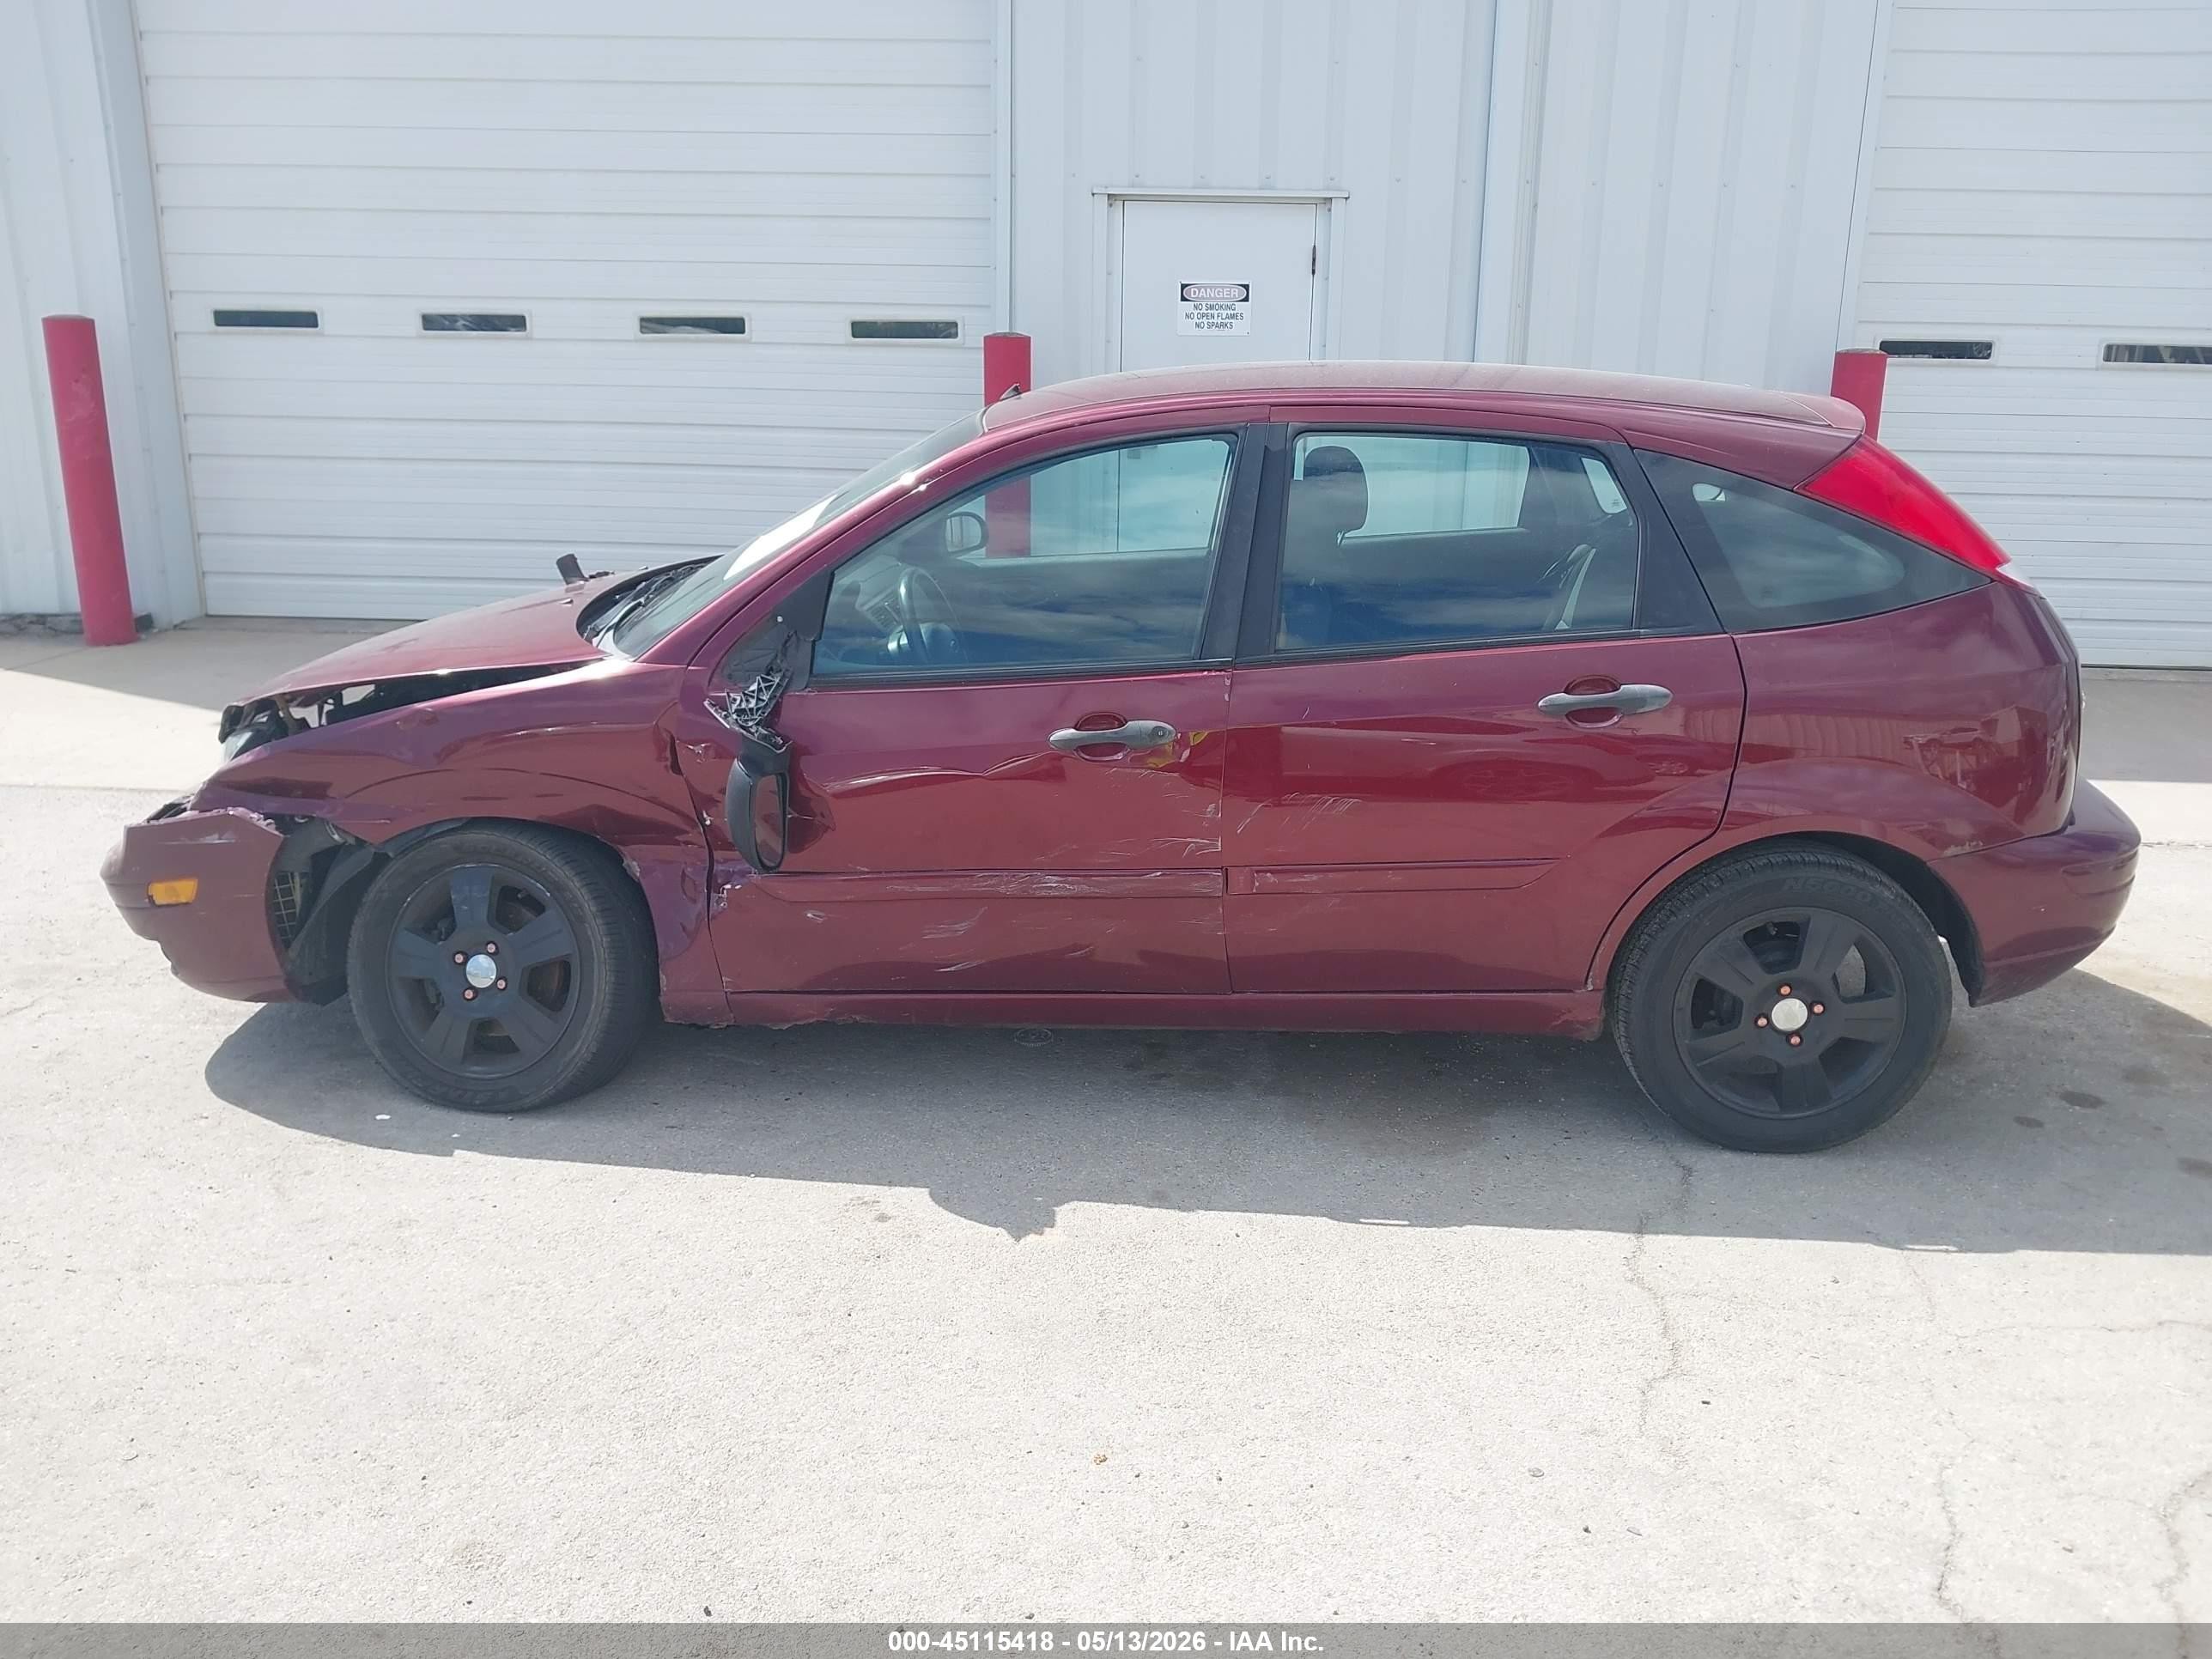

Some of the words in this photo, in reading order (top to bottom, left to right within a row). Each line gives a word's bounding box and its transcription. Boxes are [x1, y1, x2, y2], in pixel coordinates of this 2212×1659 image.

[1190, 288, 1239, 298] DANGER
[1193, 302, 1203, 311] NO
[1205, 302, 1237, 312] SMOKING
[1185, 312, 1195, 320] NO
[1196, 312, 1215, 320] OPEN
[1217, 312, 1244, 321] FLAMES
[1194, 321, 1205, 330] NO
[1206, 321, 1234, 330] SPARKS
